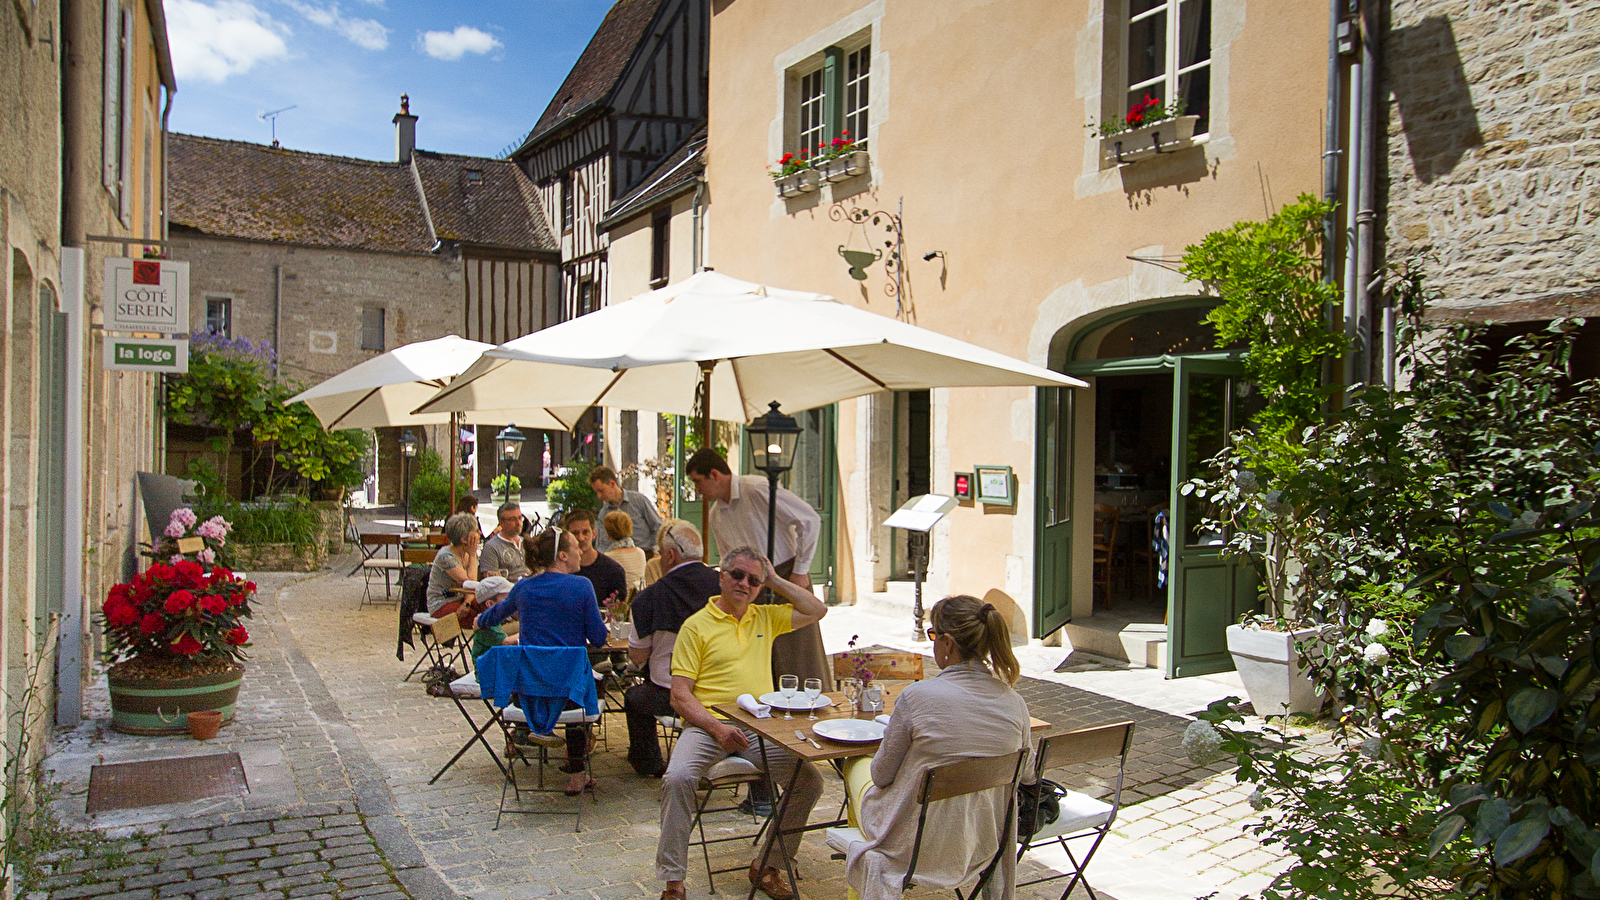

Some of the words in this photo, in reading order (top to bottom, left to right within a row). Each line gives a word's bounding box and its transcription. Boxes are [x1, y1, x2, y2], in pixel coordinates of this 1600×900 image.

[125, 288, 167, 304] CÔTÉ
[118, 303, 173, 317] SEREIN
[119, 347, 134, 359] la
[138, 348, 172, 362] loge
